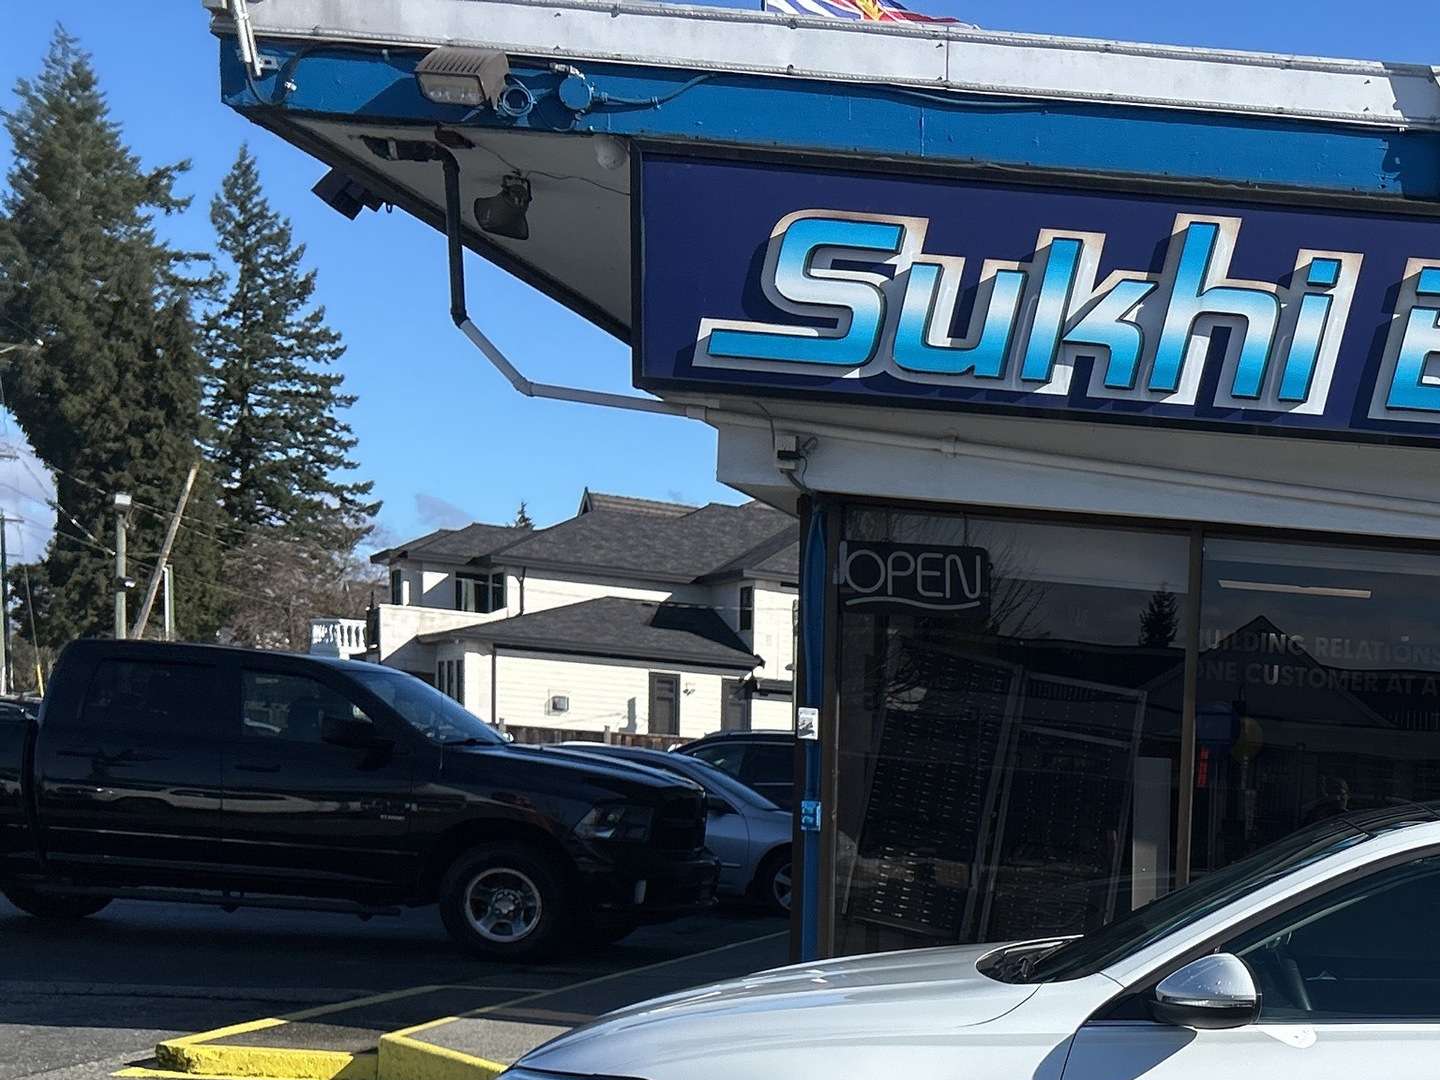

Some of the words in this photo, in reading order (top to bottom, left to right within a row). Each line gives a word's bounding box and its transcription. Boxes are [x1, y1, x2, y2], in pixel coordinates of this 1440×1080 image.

[693, 209, 1363, 415] Sukhi
[845, 549, 982, 599] OPEN
[1246, 663, 1377, 693] CUSTOMER
[1387, 673, 1418, 695] AT
[1423, 677, 1438, 697] A
